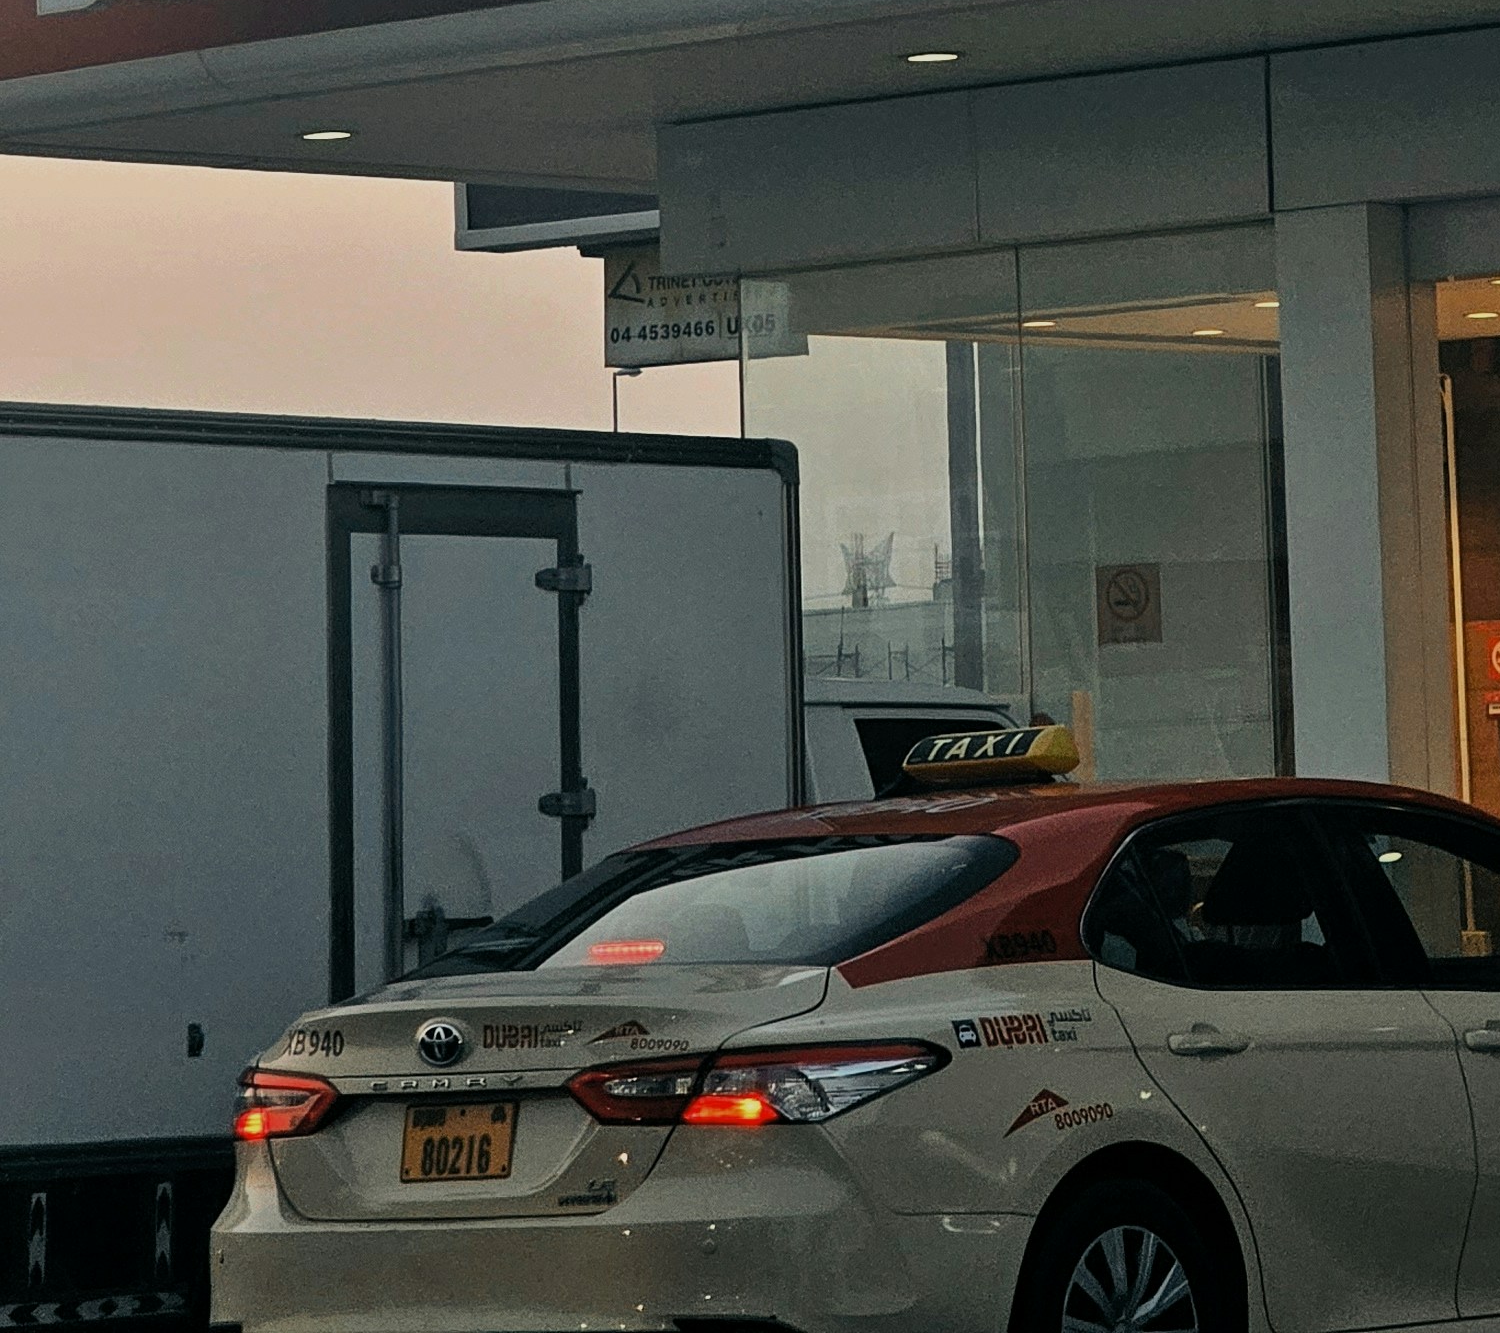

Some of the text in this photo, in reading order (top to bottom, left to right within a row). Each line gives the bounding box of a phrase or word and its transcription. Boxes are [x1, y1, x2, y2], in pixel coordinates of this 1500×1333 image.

[610, 327, 631, 344] 04
[637, 319, 715, 341] 4539466
[926, 733, 1027, 762] TAXI
[978, 1013, 1049, 1048] DUBAI
[1051, 1026, 1078, 1043] taxi
[630, 1036, 690, 1052] 8009090
[370, 1075, 526, 1090] CAMRY
[1029, 1097, 1058, 1117] RTA
[1054, 1102, 1114, 1130] 8009090
[420, 1133, 492, 1176] 80216
